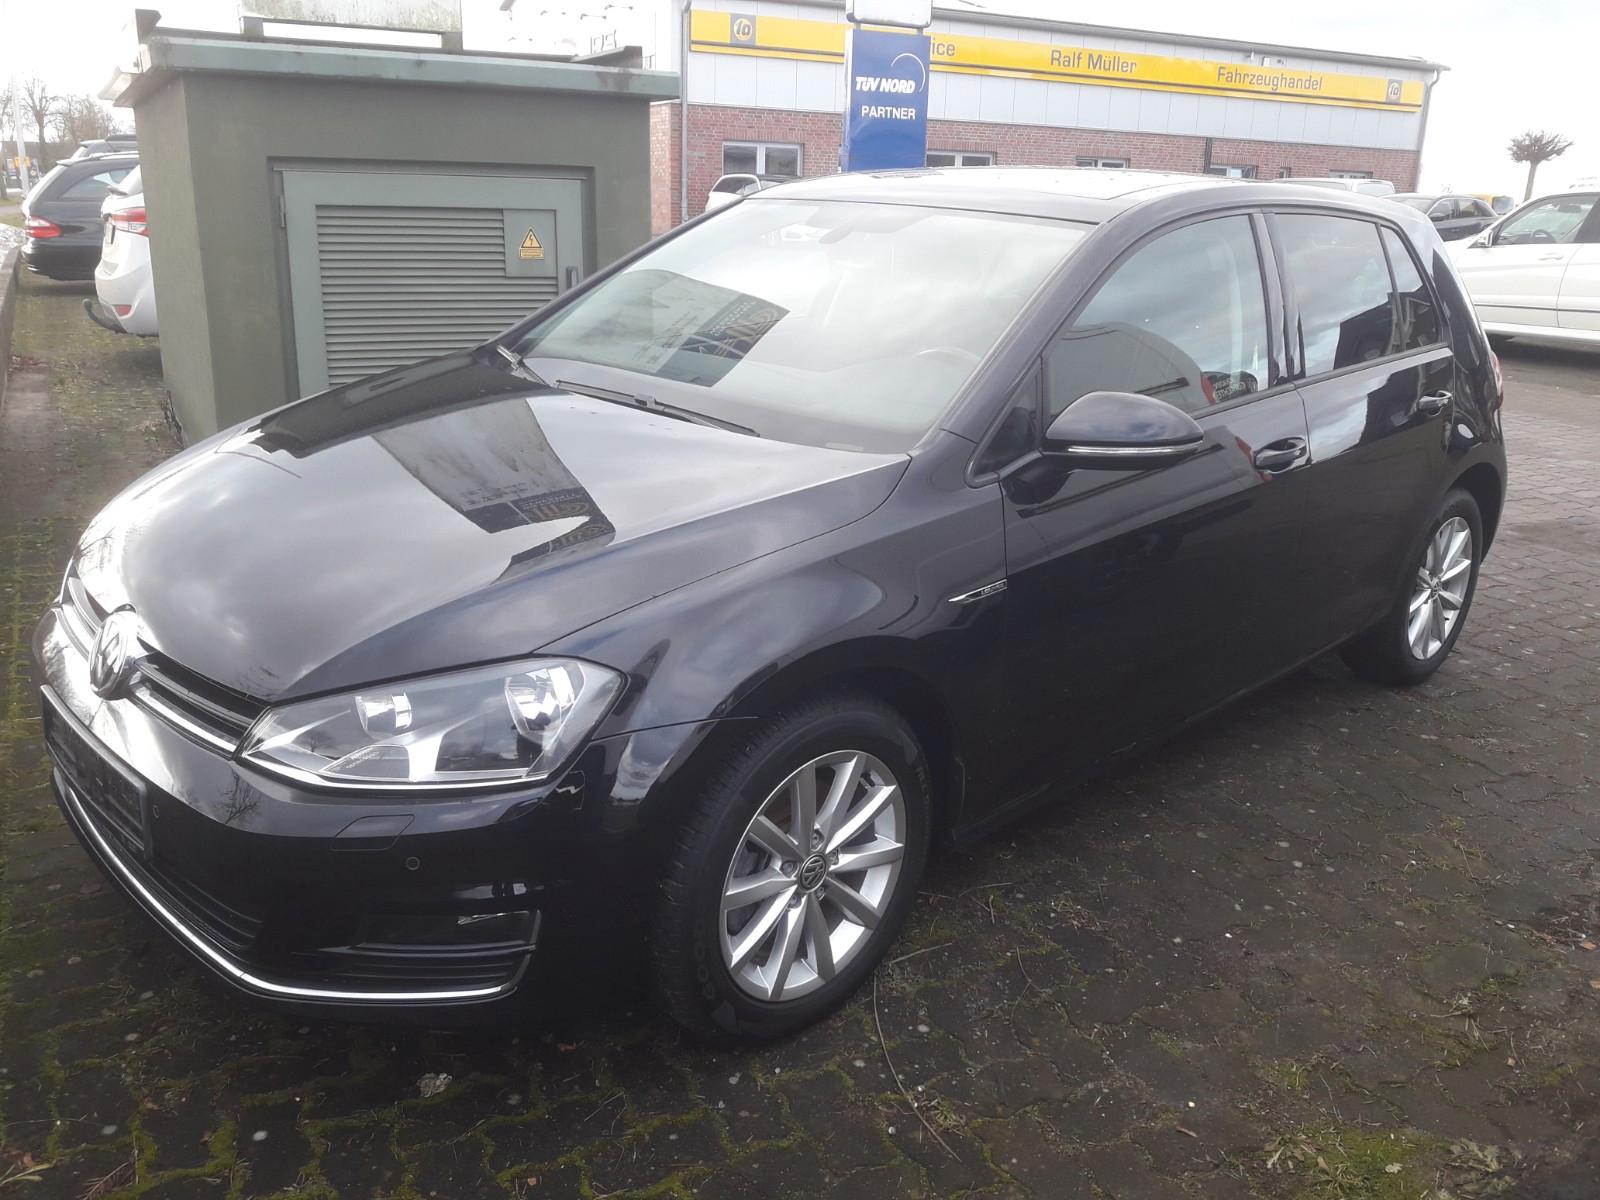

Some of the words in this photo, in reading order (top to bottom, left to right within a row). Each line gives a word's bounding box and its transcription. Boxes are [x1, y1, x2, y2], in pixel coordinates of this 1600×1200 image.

[1050, 49, 1082, 69] Ralf
[1087, 53, 1136, 73] Müller
[856, 76, 880, 92] TÜV
[879, 78, 916, 93] NORD
[1216, 65, 1323, 91] Fahrzeughandel
[861, 105, 916, 120] PARTNER
